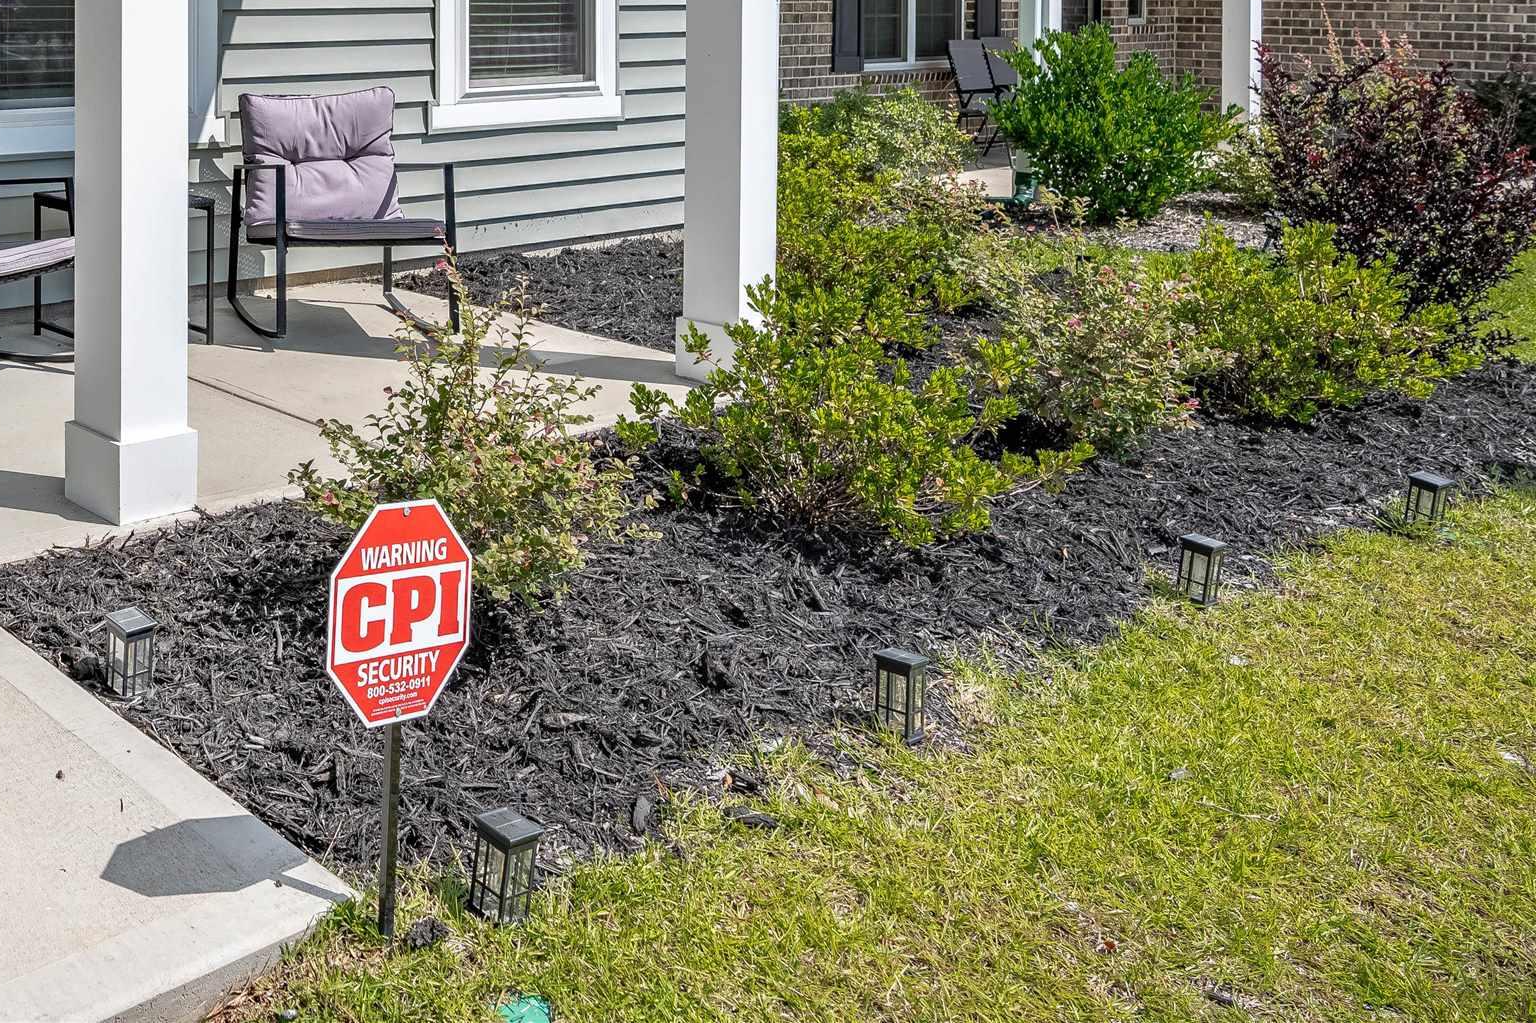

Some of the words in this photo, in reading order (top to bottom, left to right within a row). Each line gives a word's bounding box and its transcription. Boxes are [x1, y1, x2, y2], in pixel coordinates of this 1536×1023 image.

[360, 537, 448, 571] WARNING
[340, 570, 462, 653] CPI
[357, 650, 440, 687] SECURITY
[367, 675, 431, 699] 800-532-0911
